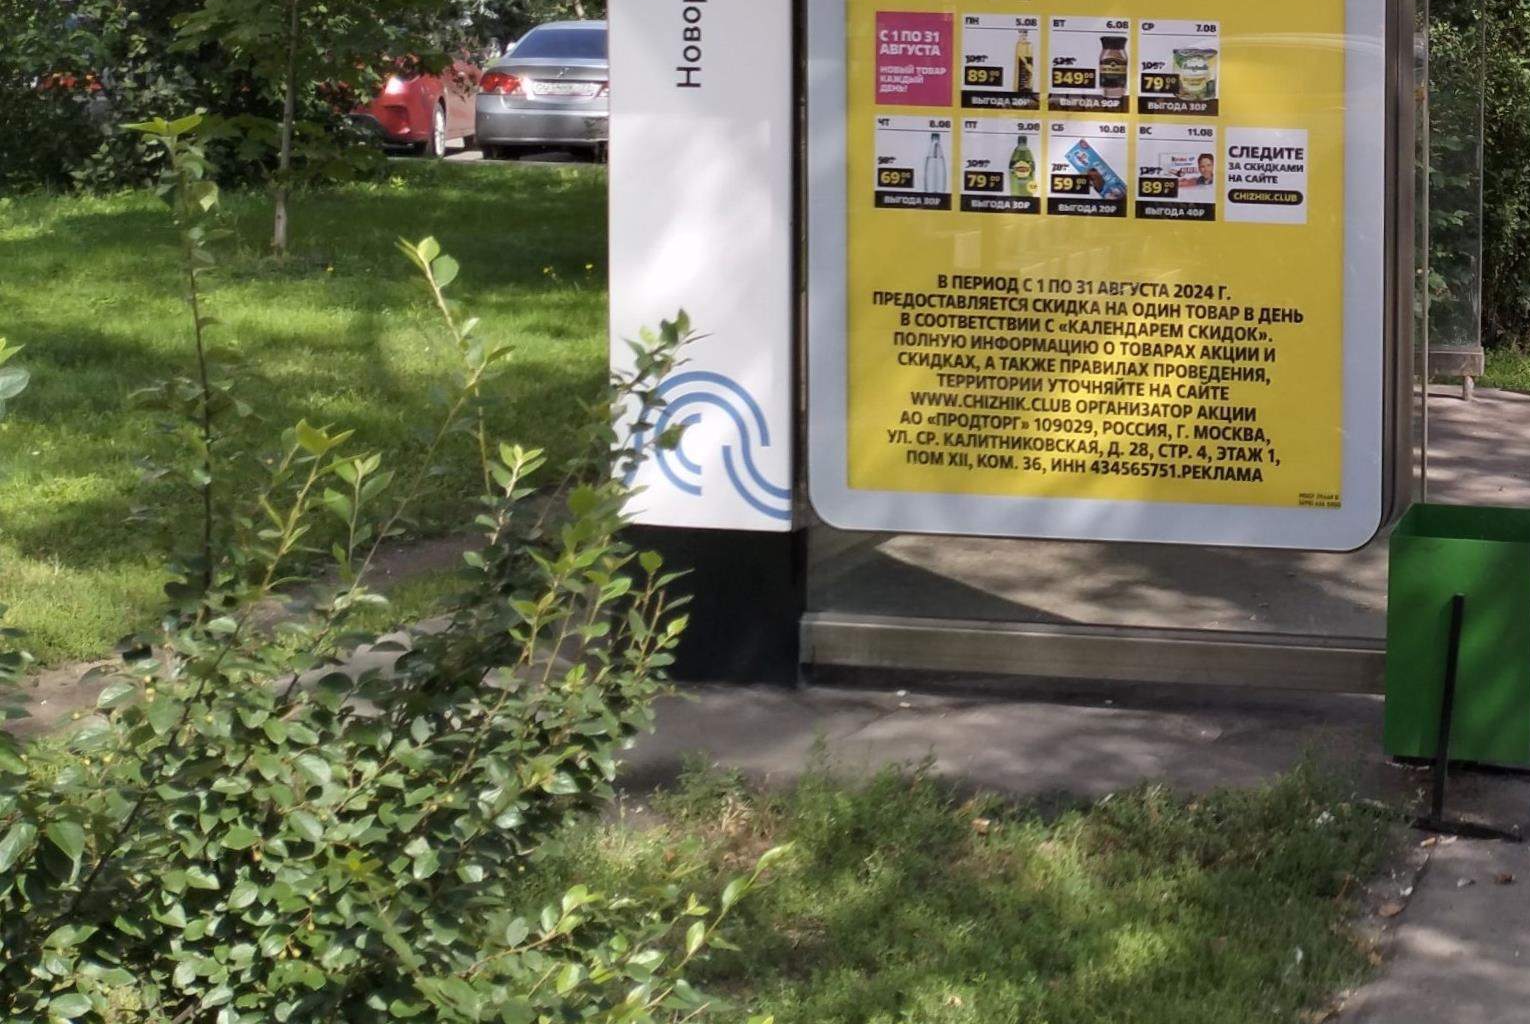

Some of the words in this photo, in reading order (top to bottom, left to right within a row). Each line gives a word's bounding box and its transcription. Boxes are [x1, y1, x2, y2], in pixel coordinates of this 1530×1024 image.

[880, 30, 889, 42] С
[892, 30, 899, 42] 1
[901, 30, 922, 42] ПО
[924, 31, 940, 43] 31
[880, 43, 941, 56] АВГУСТА
[967, 69, 988, 82] 89
[1053, 71, 1084, 85] 349
[1144, 77, 1164, 90] 79
[1052, 124, 1064, 132] СБ
[1099, 125, 1126, 133] 10.08
[1139, 127, 1152, 135] ВС
[1188, 128, 1213, 137] 11.08
[1229, 146, 1304, 161] СЛЕДИТЕ
[1229, 162, 1241, 171] ЗА
[1244, 163, 1304, 173] СКИДКАМИ
[880, 171, 901, 184] 69
[967, 174, 987, 187] 79
[1053, 178, 1073, 190] 59
[1228, 174, 1242, 183] НА
[1245, 173, 1279, 184] САЙТЕ
[1142, 181, 1162, 194] 89
[1233, 191, 1298, 202] CHIZHIK.CLUB
[936, 273, 949, 289] В
[950, 274, 1021, 296] ПЕРИОД
[1022, 277, 1033, 293] С
[1036, 278, 1045, 294] 1
[1047, 278, 1073, 295] ПО
[1075, 279, 1094, 296] 31
[1096, 280, 1171, 299] АВГУСТА
[1172, 283, 1216, 301] 2024
[1217, 285, 1232, 301] Г.
[871, 290, 1029, 313] ПРЕДОСТАВЛЯЕТСЯ
[1031, 297, 1102, 318] СКИДКА
[1104, 300, 1129, 317] НА
[1131, 301, 1182, 321] ОДИН
[1184, 303, 1241, 321] ТОВАР
[1243, 306, 1255, 322] В
[1257, 306, 1305, 326] ДЕНЬ
[899, 311, 912, 327] В
[913, 312, 1042, 333] СООТВЕТСТВИИ
[1043, 317, 1056, 334] С
[1058, 318, 1185, 340] «КАЛЕНДАРЕМ
[1187, 323, 1274, 345] СКИДОК».
[893, 330, 968, 350] ПОЛНУЮ
[969, 334, 1100, 358] ИНФОРМАЦИЮ
[1102, 340, 1116, 356] О
[1119, 340, 1197, 363] ТОВАРАХ
[1199, 344, 1260, 365] АКЦИИ
[1263, 346, 1276, 363] И
[897, 350, 982, 373] СКИДКАХ,
[983, 355, 997, 371] А
[997, 355, 1057, 374] ТАКЖЕ
[1059, 358, 1153, 381] ПРАВИЛАХ
[1152, 362, 1271, 387] ПРОВЕДЕНИЯ,
[935, 372, 1044, 393] ТЕРРИТОРИИ
[1047, 377, 1146, 397] УТОЧНЯЙТЕ
[1148, 382, 1173, 399] НА
[1175, 383, 1231, 402] САЙТЕ
[909, 391, 1073, 414] WWW.CHIZHIK.CLUB
[1075, 398, 1194, 419] ОРГАНИЗАТОР
[1195, 404, 1257, 425] АКЦИИ
[899, 410, 924, 426] АО
[926, 411, 1031, 432] «ПРОДТОРГ»
[1033, 417, 1099, 438] 109029,
[1101, 419, 1173, 442] РОССИЯ,
[1176, 423, 1190, 440] Г.
[1193, 424, 1272, 447] МОСКВА,
[886, 428, 913, 445] УЛ.
[915, 430, 940, 447] СР.
[942, 431, 1106, 459] КАЛИТНИКОВСКАЯ,
[1105, 440, 1126, 460] Д.
[1127, 441, 1155, 462] 28,
[1157, 442, 1193, 460] СТР.
[1195, 444, 1213, 464] 4,
[1215, 445, 1264, 464] ЭТАЖ
[1267, 447, 1281, 467] 1,
[905, 449, 945, 466] ПОМ
[946, 451, 974, 471] XII,
[976, 453, 1019, 471] КОМ.
[1022, 455, 1048, 475] 36,
[1051, 458, 1087, 475] ИНН
